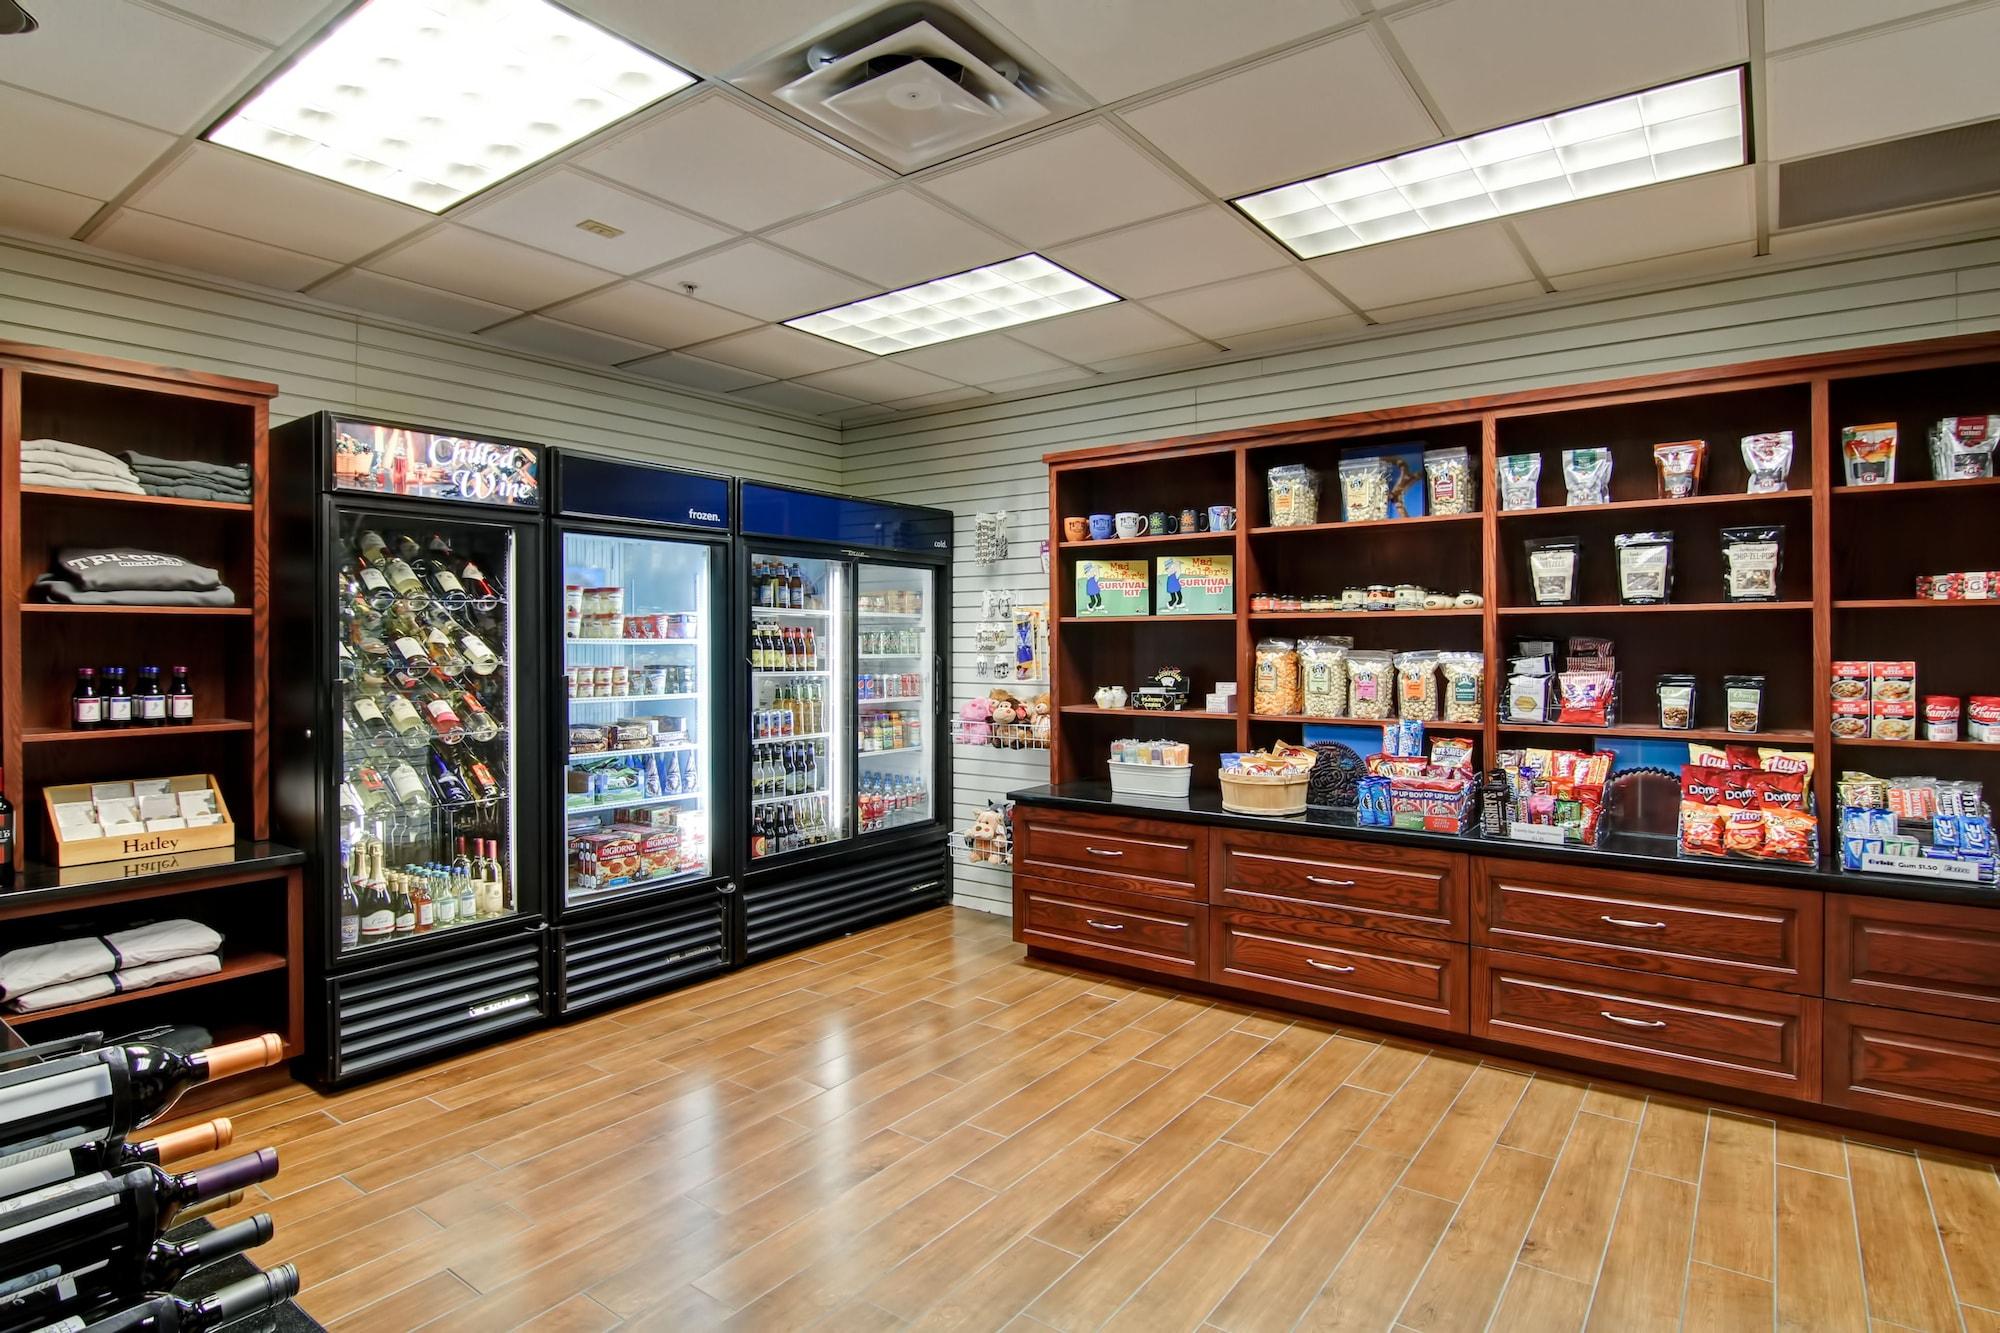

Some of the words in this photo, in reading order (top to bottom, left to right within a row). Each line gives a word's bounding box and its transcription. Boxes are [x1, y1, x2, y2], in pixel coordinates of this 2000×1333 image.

[429, 436, 519, 468] Chilled
[453, 469, 532, 499] Wine
[688, 508, 721, 522] frozen.
[933, 539, 948, 549] cold.
[1098, 581, 1147, 589] SURVIVAL
[1179, 578, 1231, 586] SURVIVAL
[1206, 586, 1224, 594] KIT
[122, 836, 179, 855] Hatley
